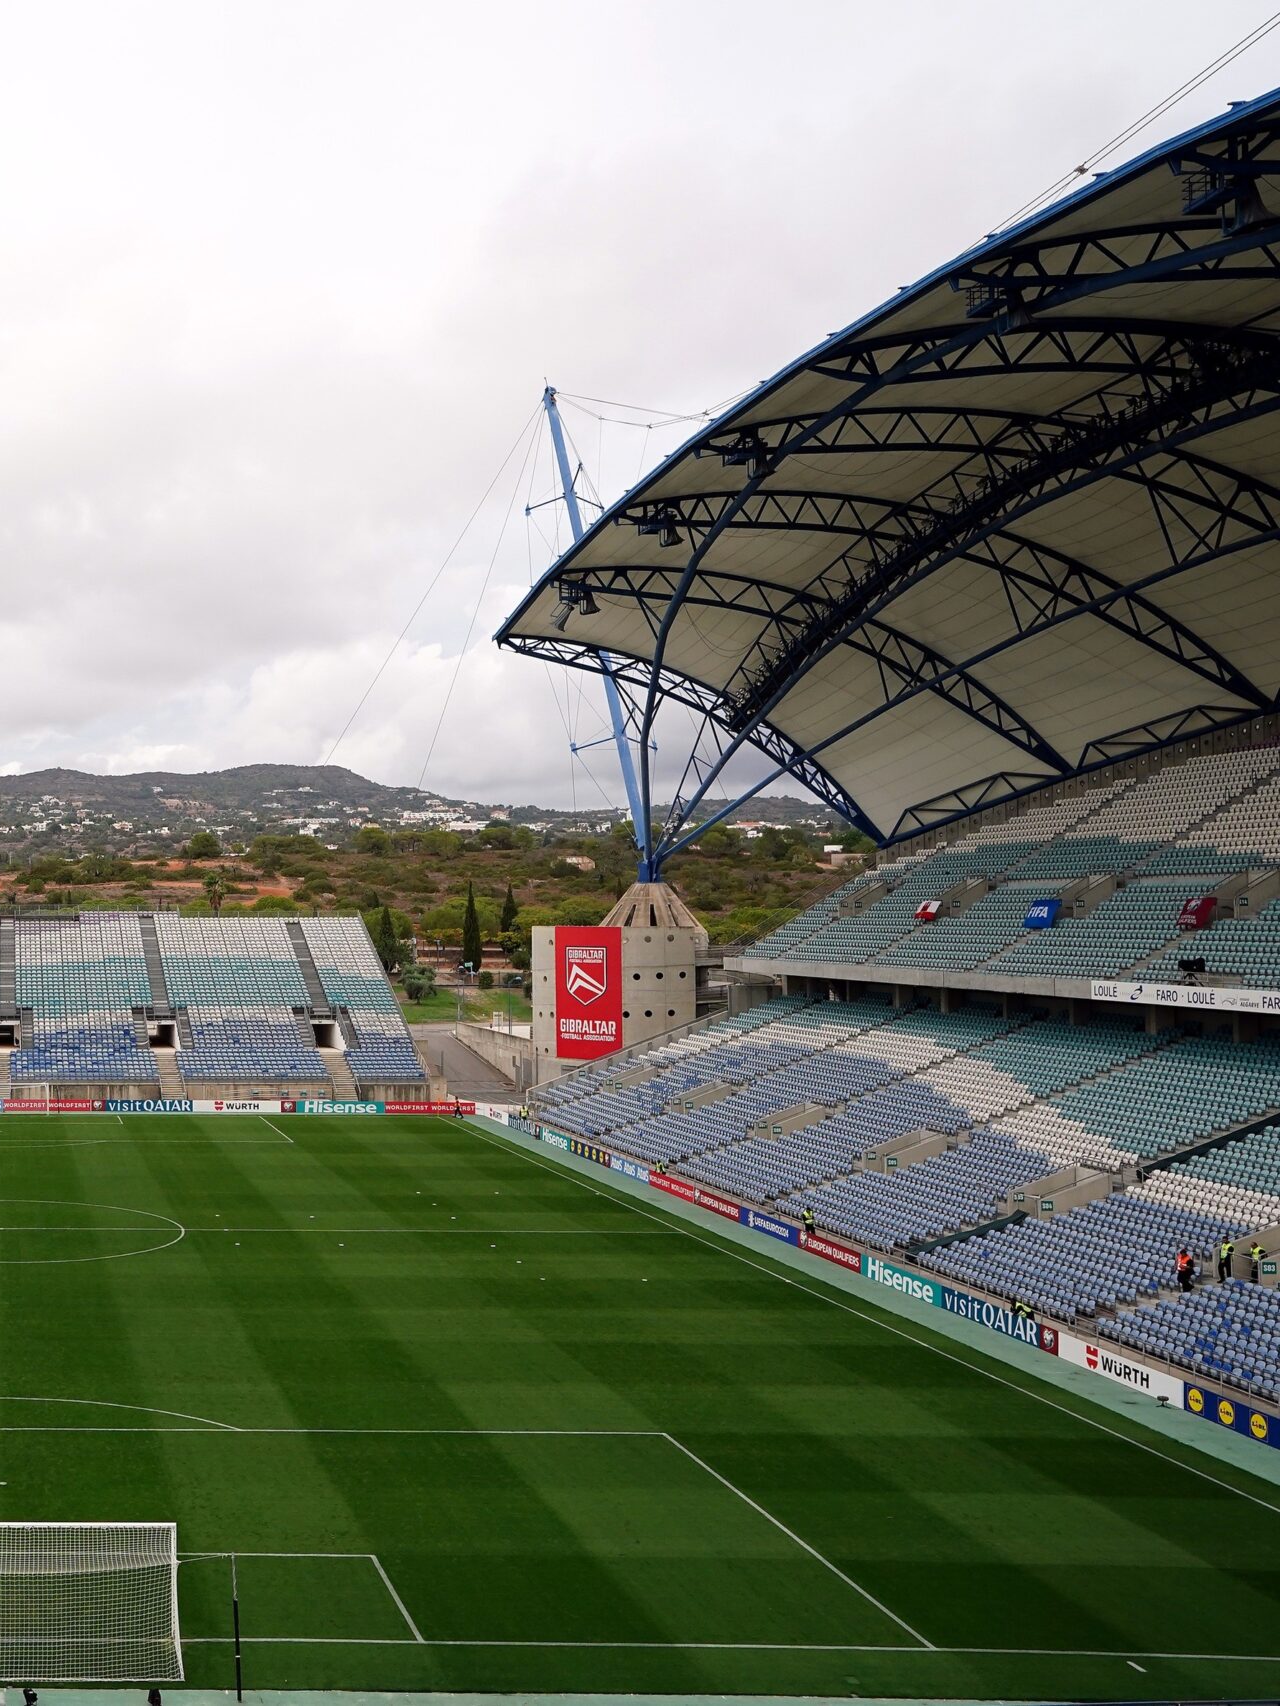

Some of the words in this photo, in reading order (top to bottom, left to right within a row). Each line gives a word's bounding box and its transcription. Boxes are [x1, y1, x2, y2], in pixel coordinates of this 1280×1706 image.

[1028, 906, 1048, 918] FIFA
[569, 950, 603, 959] GIBRALTAR
[1094, 983, 1118, 998] LOULÉ
[1156, 990, 1178, 1002] FARO
[1187, 990, 1215, 1005] LOULÉ
[560, 1018, 616, 1035] GIBRALTAR
[225, 1102, 260, 1110] WÜRTH
[304, 1100, 377, 1114] Hisense
[542, 1127, 568, 1151] Hisense
[649, 1174, 671, 1189] WORLDFIRST
[670, 1183, 694, 1199] WORLDFIRST
[700, 1194, 719, 1210] EUROPEAN
[719, 1200, 739, 1218] QUALIFIERS
[808, 1238, 832, 1255] EUROPEAN
[832, 1248, 860, 1268] QUALIFIERS
[867, 1256, 934, 1304] Hisense
[1101, 1355, 1150, 1389] WÜRTH
